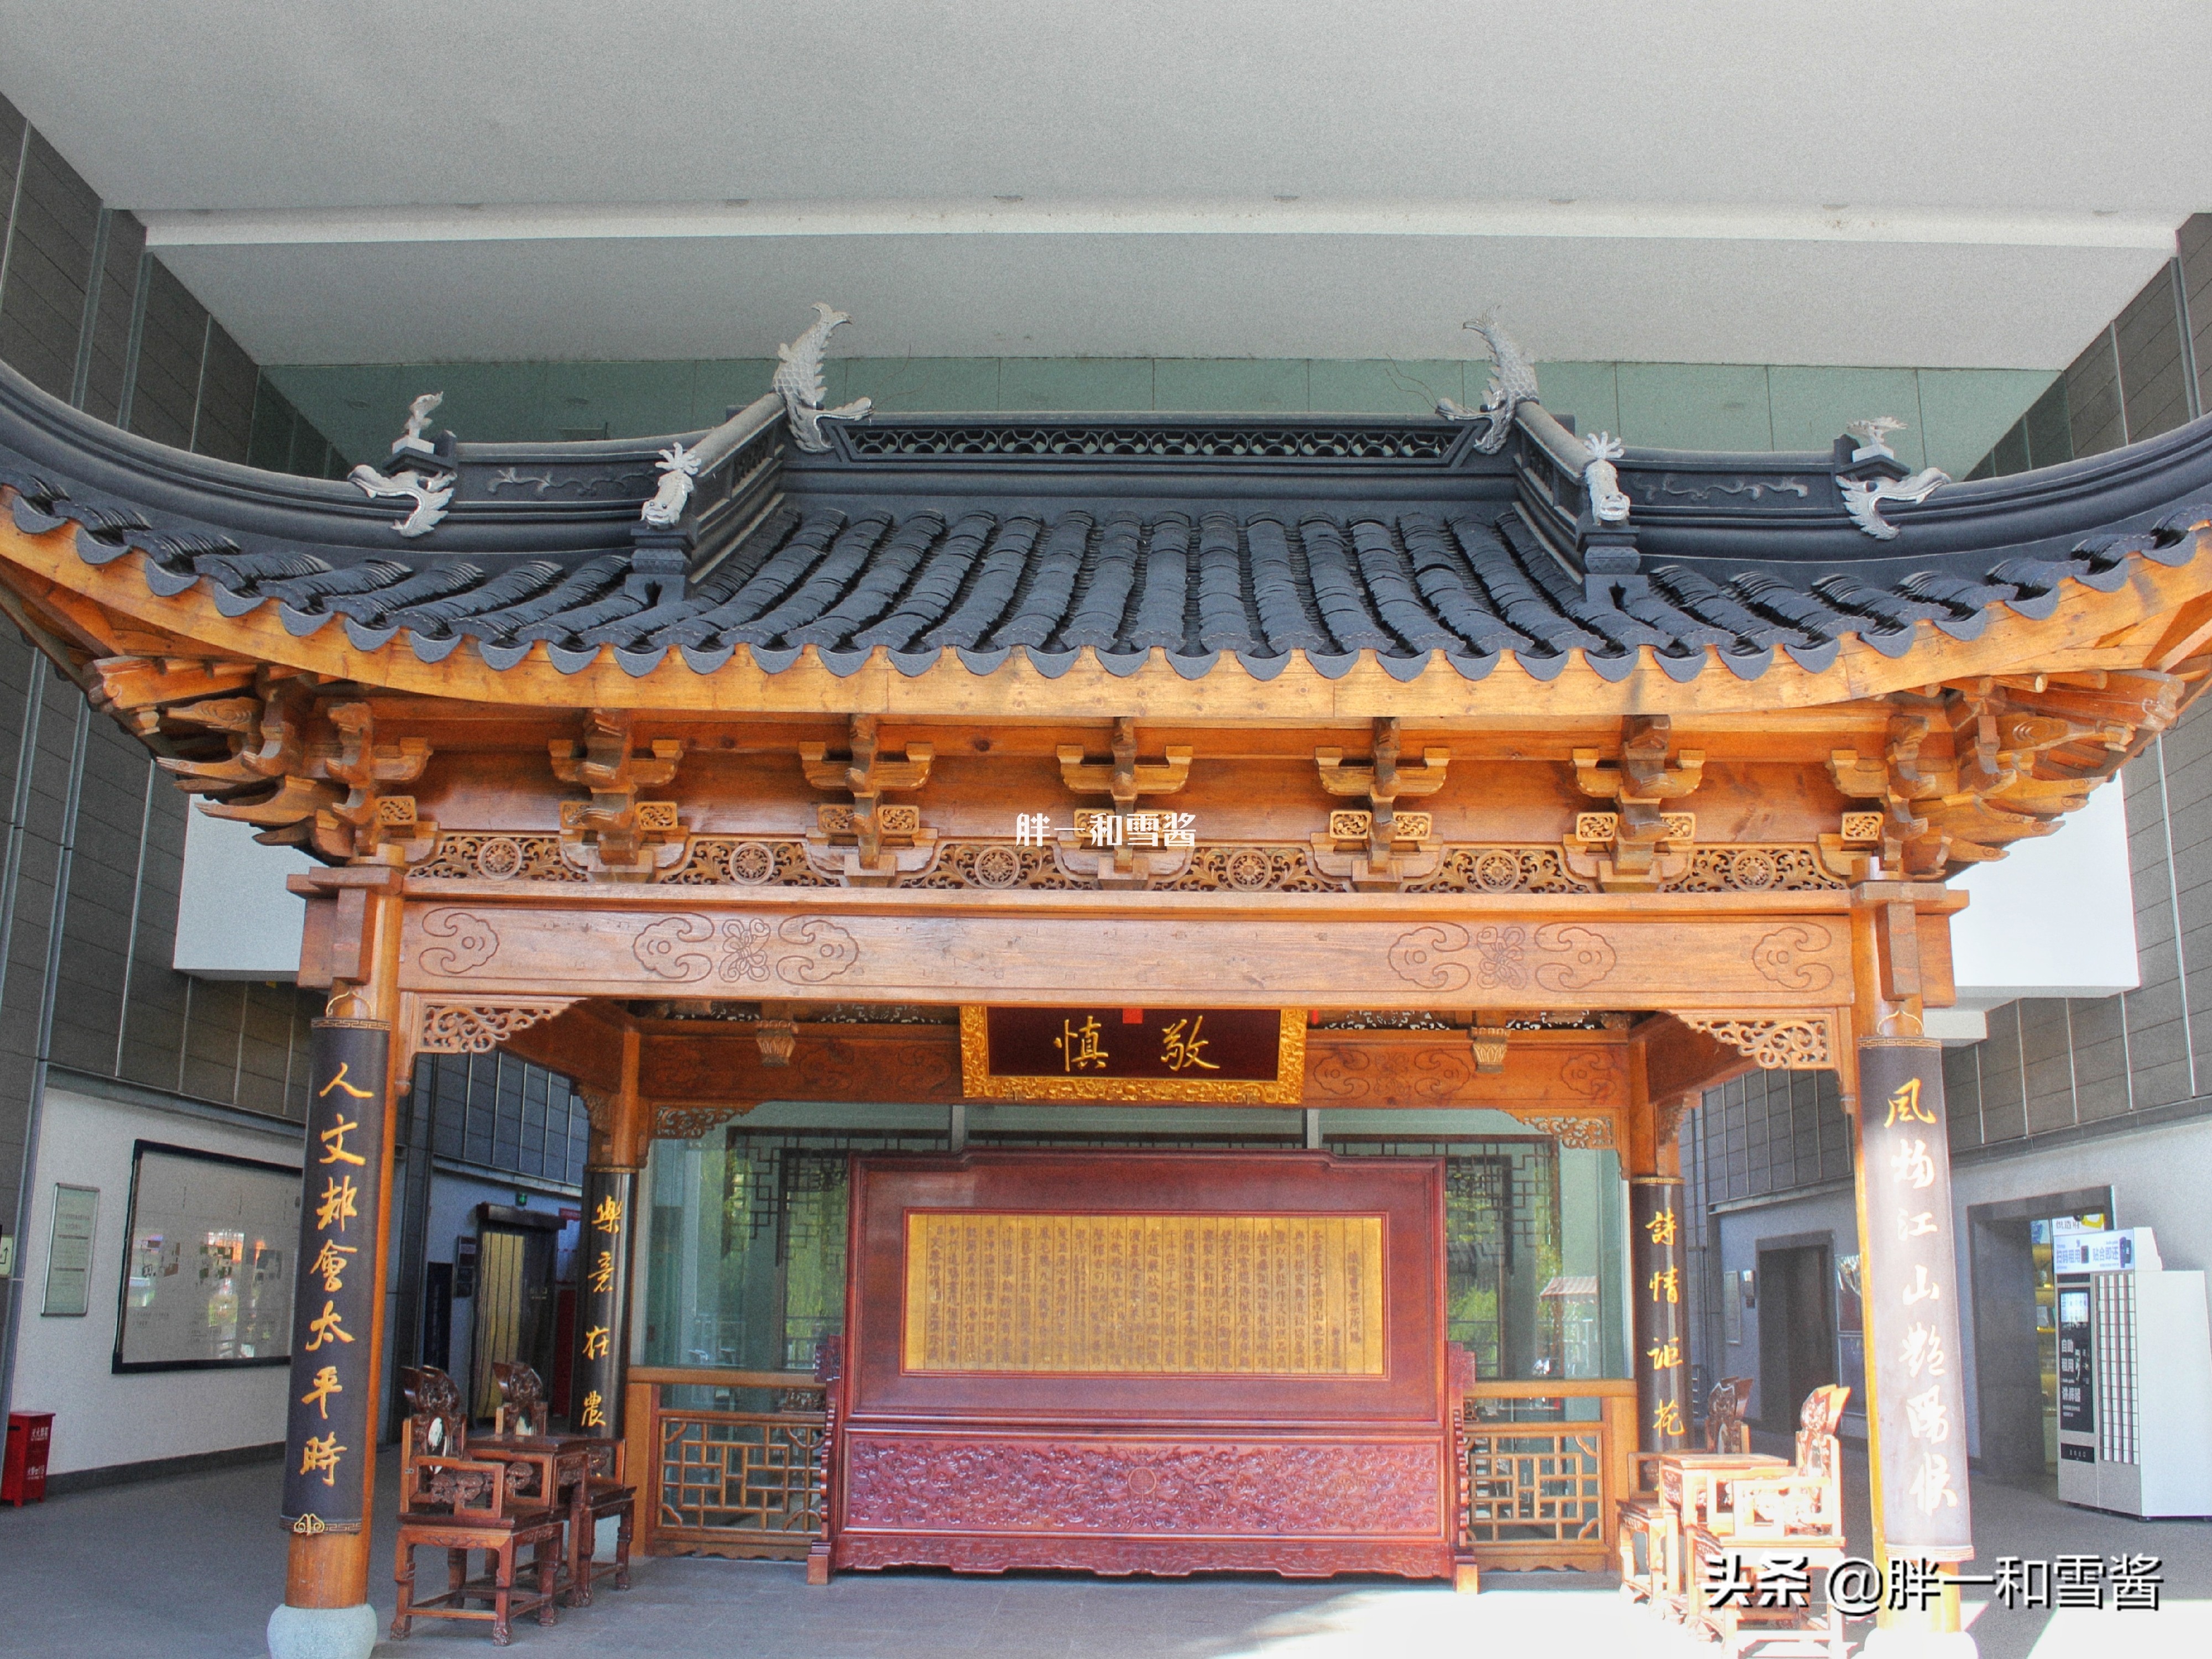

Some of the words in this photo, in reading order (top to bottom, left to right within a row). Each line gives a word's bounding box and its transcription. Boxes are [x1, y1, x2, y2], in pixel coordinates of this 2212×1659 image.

[2056, 1249, 2080, 1264] 扫码租用
[2061, 1338, 2074, 1353] 自助
[2061, 1358, 2074, 1373] 租用
[2062, 1386, 2081, 1402] 讲解器
